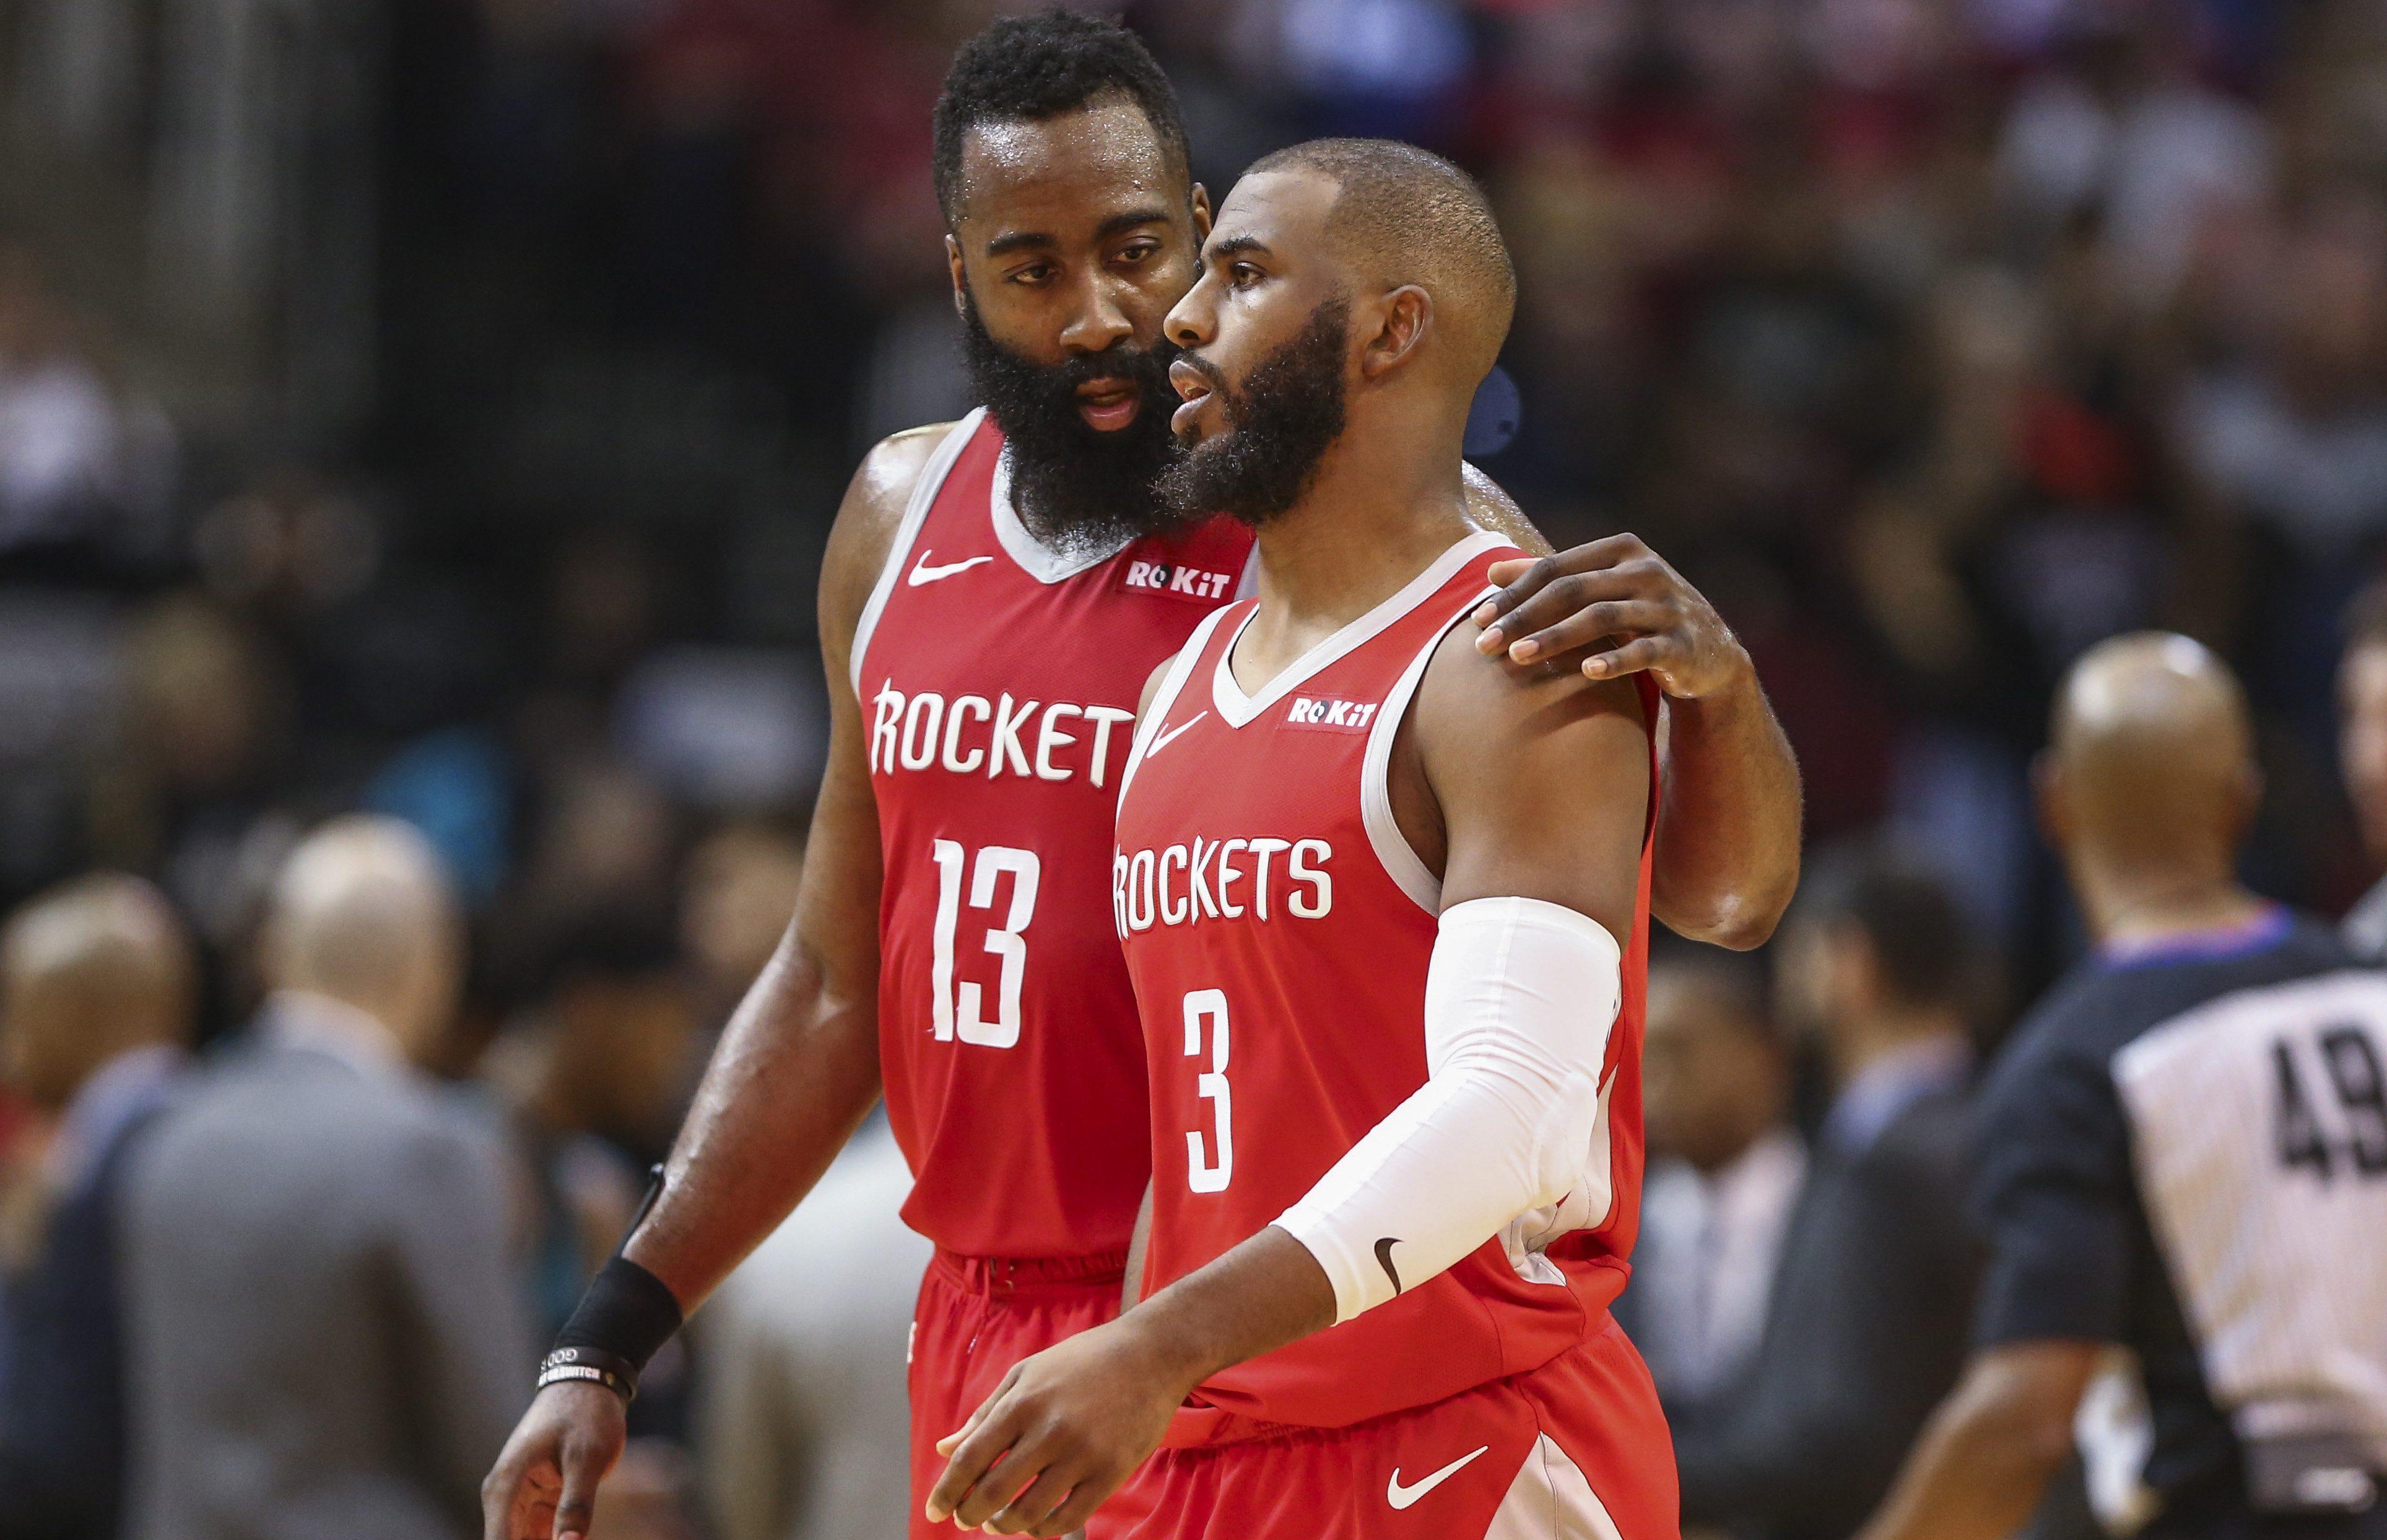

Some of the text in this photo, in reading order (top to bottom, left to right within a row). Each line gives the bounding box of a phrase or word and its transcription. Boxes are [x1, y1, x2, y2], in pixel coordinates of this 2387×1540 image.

[1126, 560, 1231, 599] ROKiT
[871, 677, 1136, 788] ROCKET
[1287, 697, 1378, 728] ROKiT
[932, 838, 1041, 1049] 13
[1113, 834, 1333, 942] ROCKETS
[1183, 988, 1233, 1194] 3
[2270, 1023, 2387, 1189] 49
